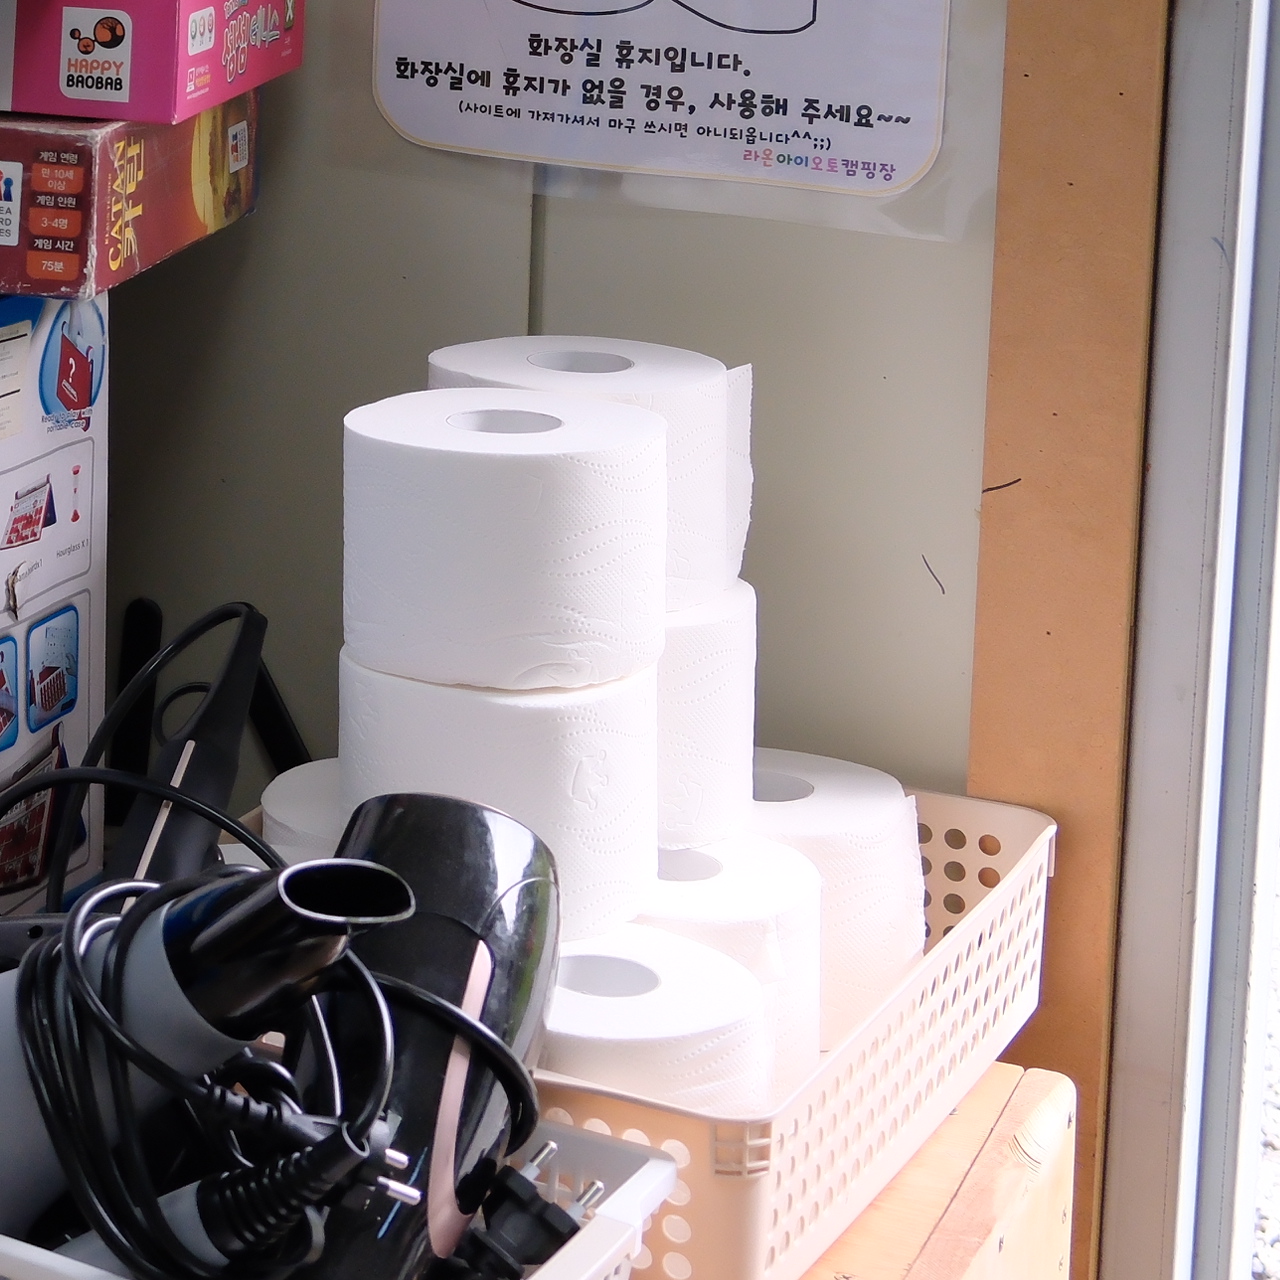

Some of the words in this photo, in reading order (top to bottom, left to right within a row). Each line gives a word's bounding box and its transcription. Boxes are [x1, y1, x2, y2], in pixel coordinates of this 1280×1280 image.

[528, 33, 601, 68] 화장실
[616, 38, 752, 78] 휴지입니다.
[67, 58, 124, 76] HAPPY
[66, 74, 123, 92] BAOBAB
[395, 57, 491, 91] 화장실에
[502, 67, 571, 99] 휴지가
[581, 76, 627, 108] 없을
[641, 83, 696, 116] 경우,
[709, 89, 788, 120] 사용해
[458, 100, 522, 122] (사이트에
[528, 106, 601, 129] 가져가셔서
[608, 117, 636, 135] 마구
[644, 121, 689, 139] 쓰시면
[38, 151, 59, 163] 게임
[61, 152, 79, 165] 연령
[742, 147, 897, 181] 라온아이오토캠핑장
[41, 168, 52, 179] 만
[54, 169, 74, 181] 10세
[47, 180, 67, 191] 이상
[36, 195, 55, 207] 게임
[57, 196, 76, 208] 인원
[41, 216, 69, 230] 3-4명
[34, 238, 53, 251] 게임
[55, 239, 75, 252] 시간
[42, 260, 64, 273] 75분
[56, 542, 81, 557] Hourglass
